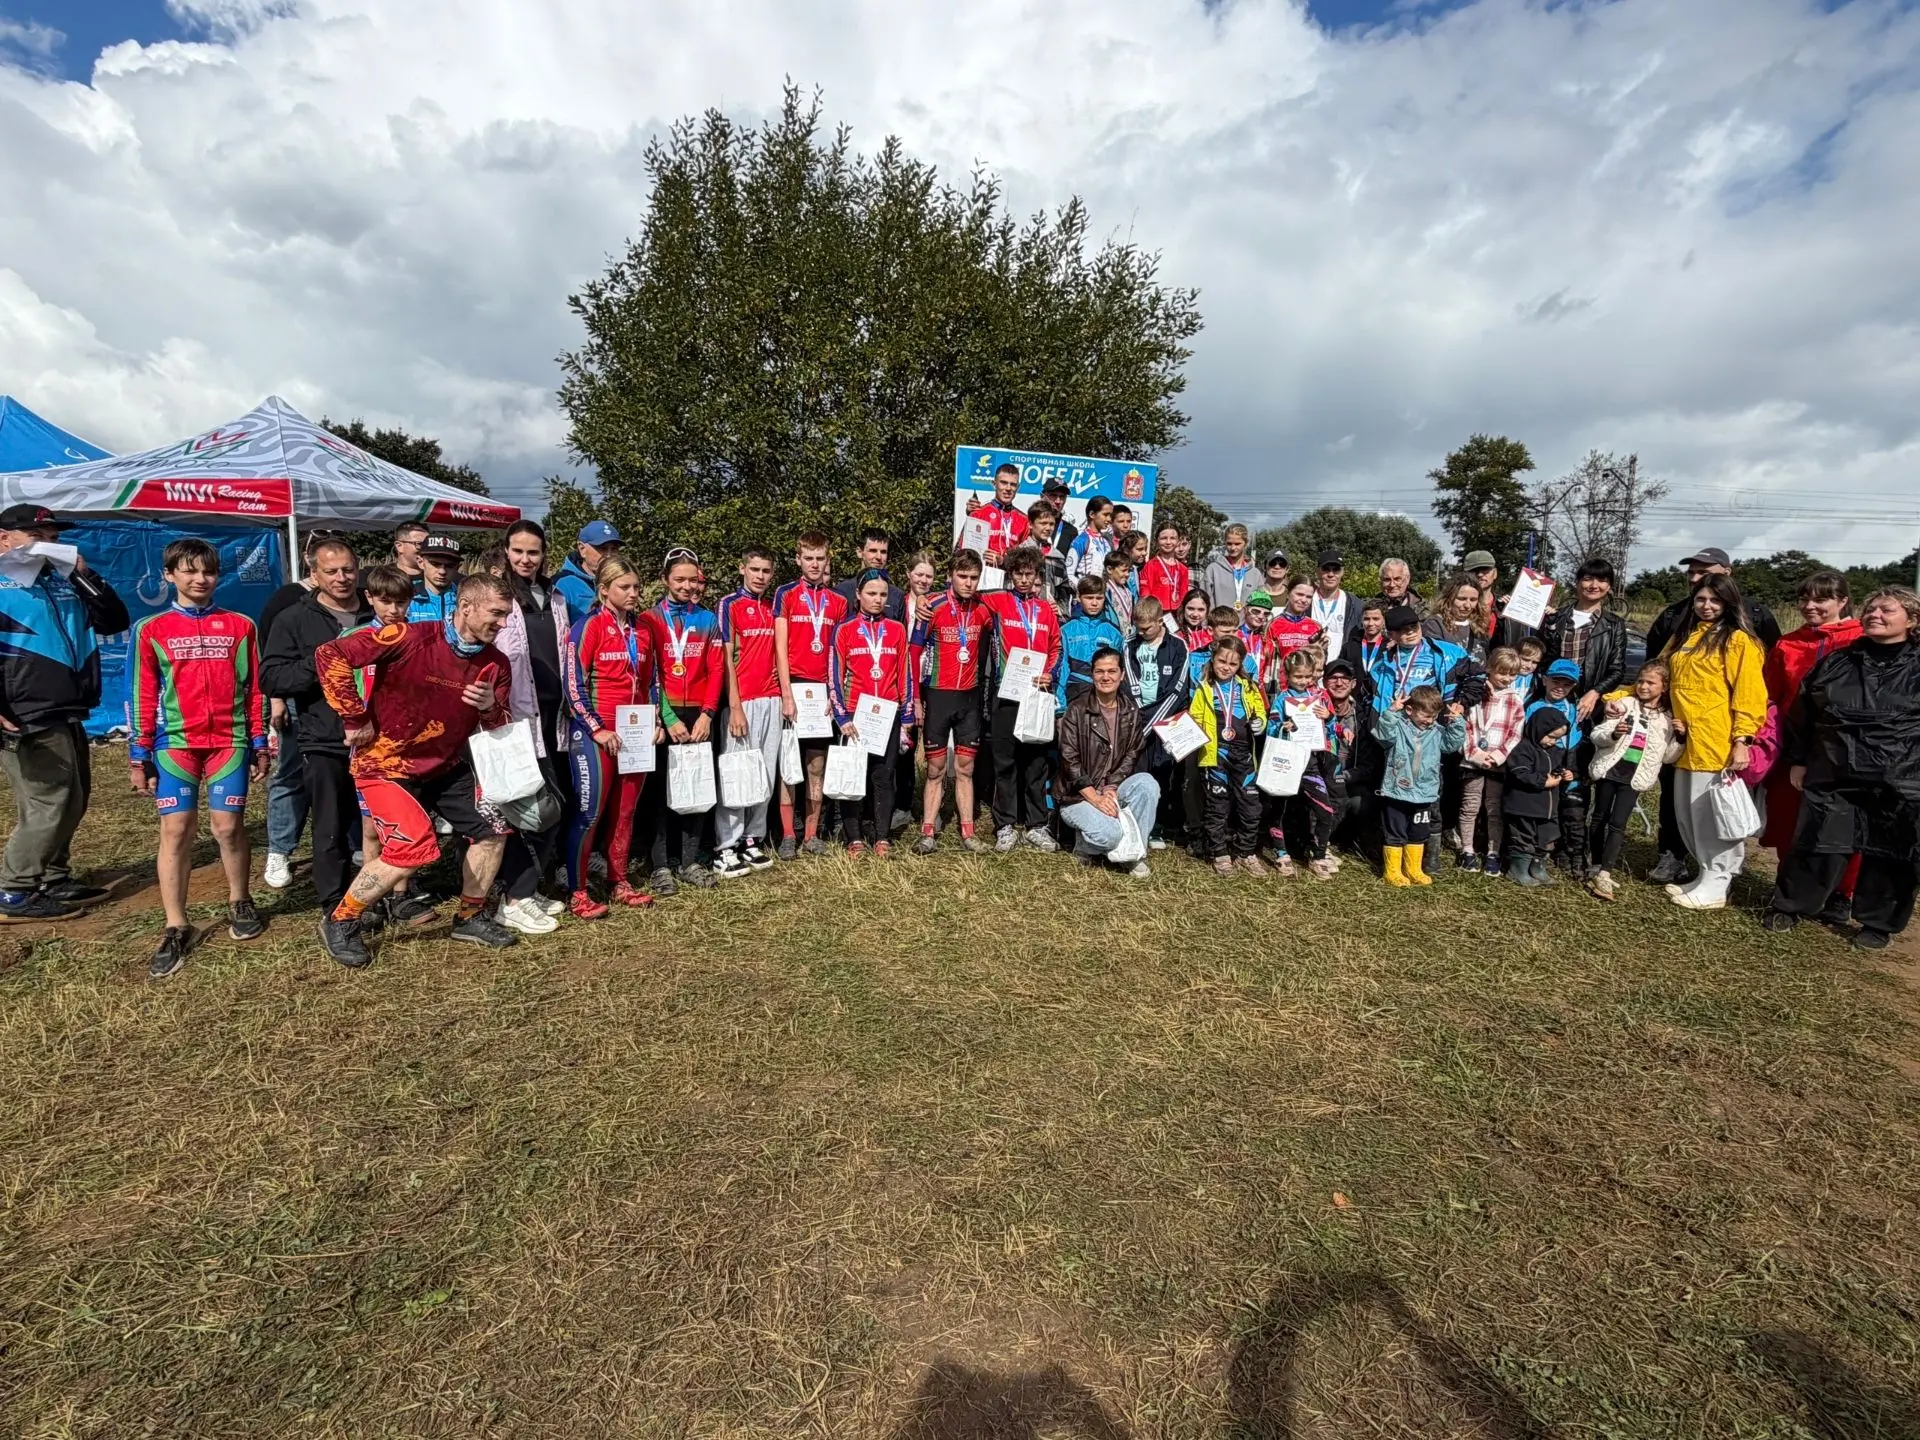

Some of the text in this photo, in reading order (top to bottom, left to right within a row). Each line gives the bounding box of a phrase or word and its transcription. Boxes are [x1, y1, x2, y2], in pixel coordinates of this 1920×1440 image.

[1009, 455, 1096, 469] СПОРТИВНАЯ ШКОЛА
[163, 481, 263, 504] MIVI Racing
[237, 500, 268, 511] team
[167, 635, 234, 649] MOSCOW
[174, 647, 229, 660] REGION
[577, 754, 590, 812] ЭЛЕКТРОСТАЛЬ
